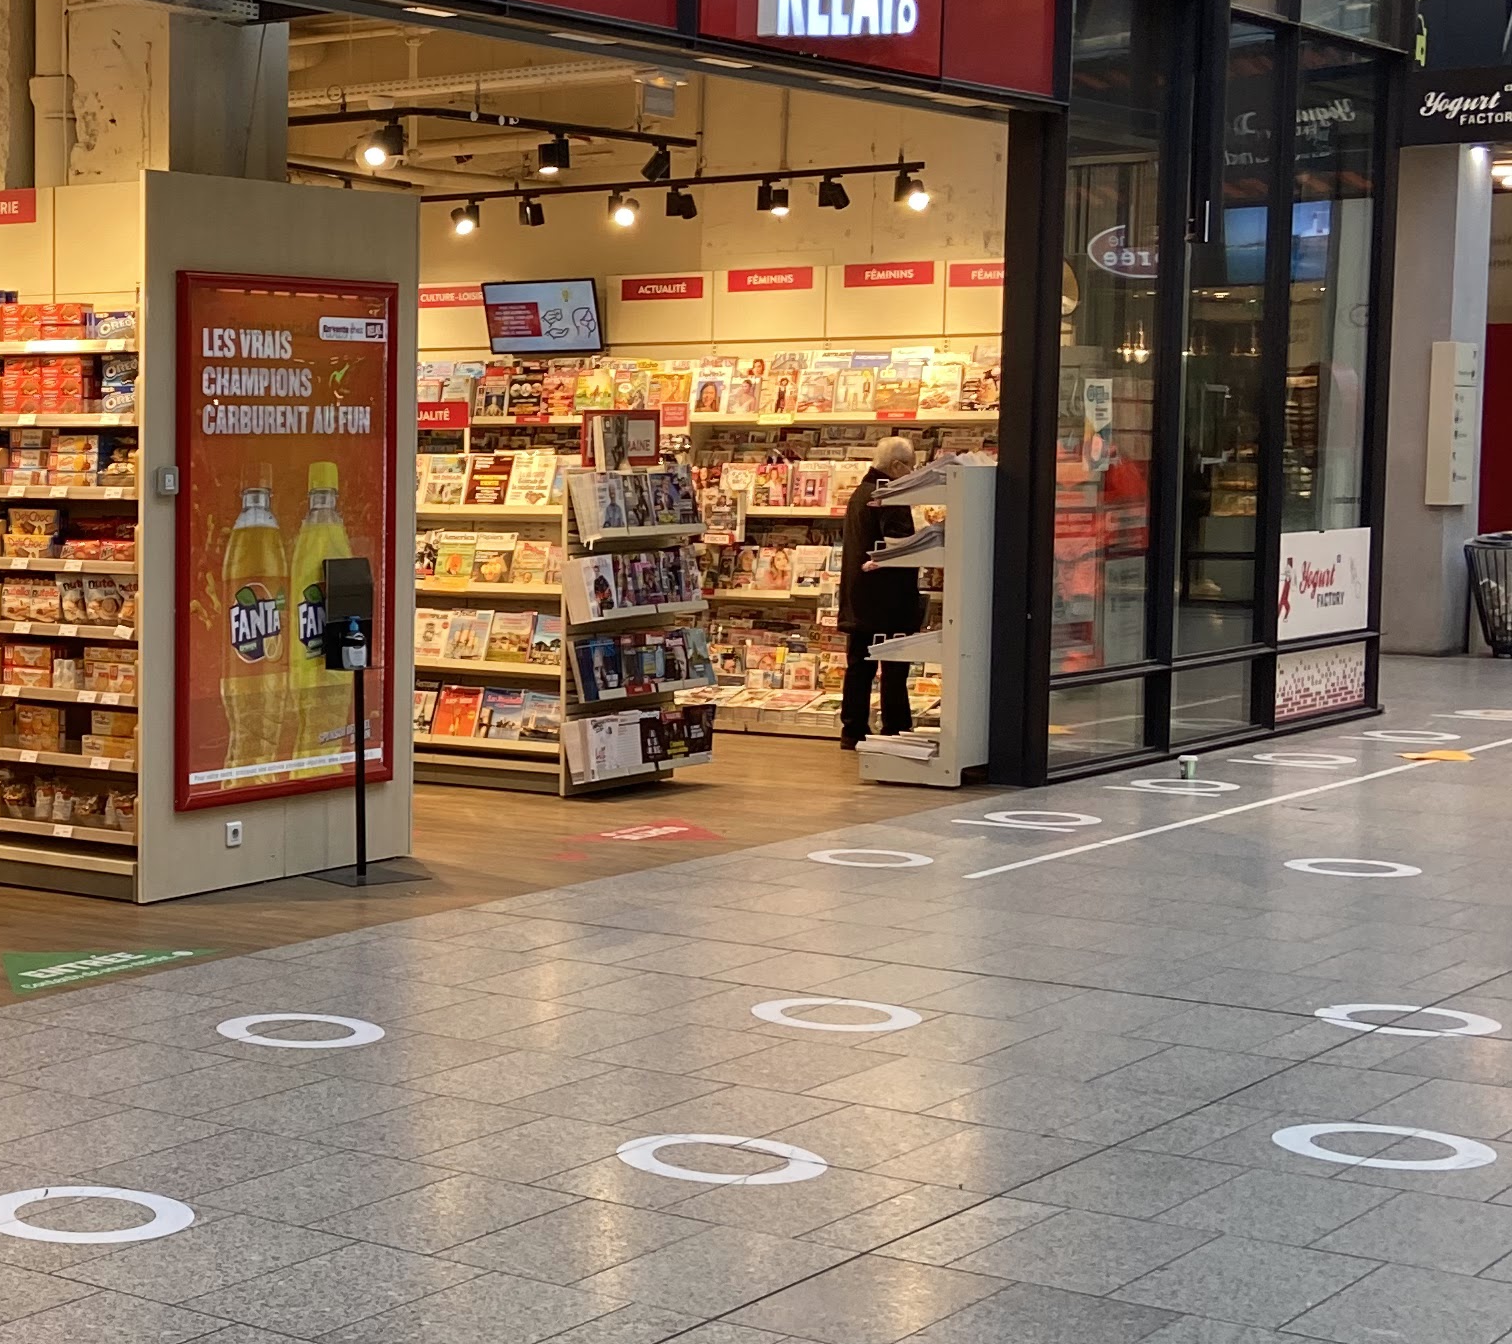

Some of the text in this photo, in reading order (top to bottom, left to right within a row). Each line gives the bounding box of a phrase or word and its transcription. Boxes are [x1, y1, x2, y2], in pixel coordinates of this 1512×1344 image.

[1419, 91, 1501, 120] Yogurt
[637, 282, 687, 294] ACTUALITÉ
[746, 274, 794, 286] FÉMININS
[864, 268, 914, 281] FÉMININS
[202, 327, 293, 360] LES VRAIS
[202, 366, 313, 397] CHAMPIONS
[202, 404, 371, 435] CARBURENT AU FUN
[1299, 560, 1336, 600] Yogurt
[1316, 591, 1345, 608] FACTORY
[230, 601, 281, 644] FANTA
